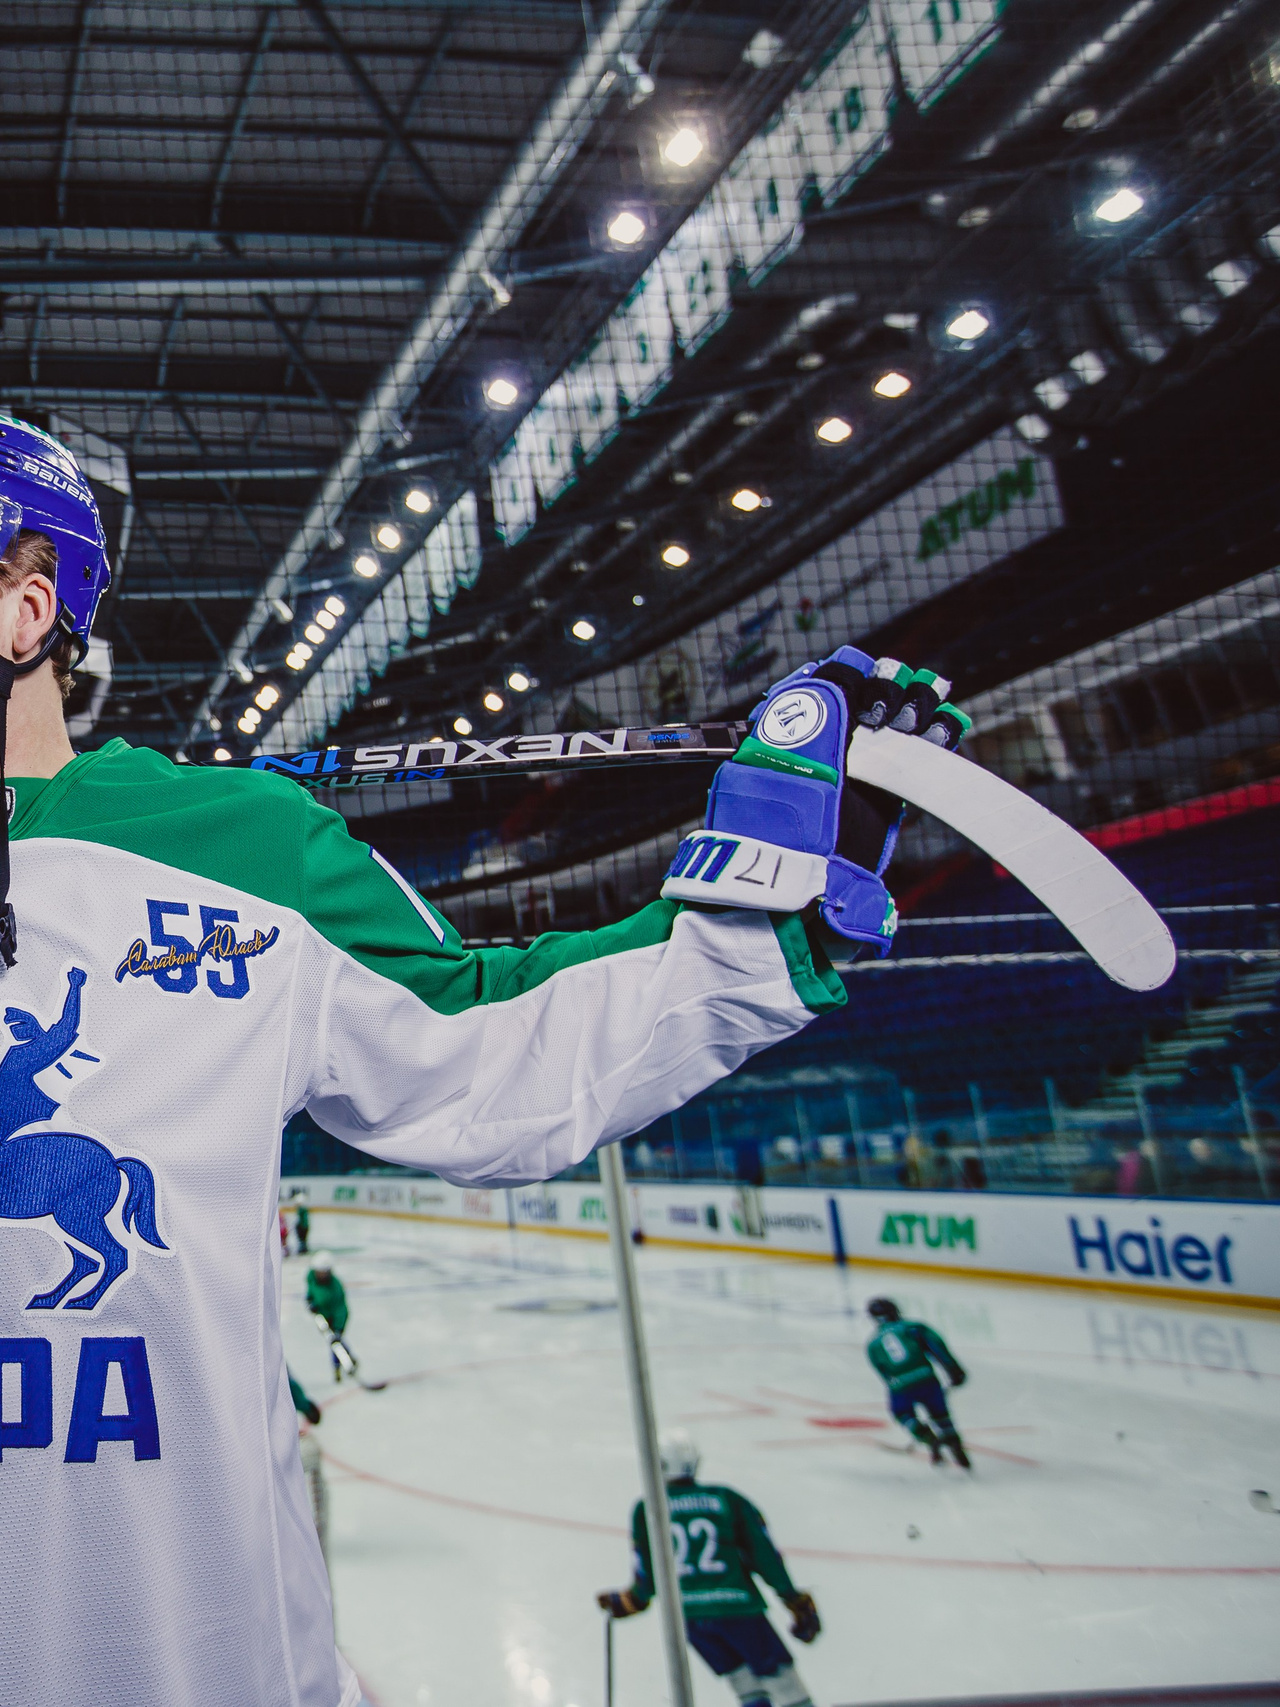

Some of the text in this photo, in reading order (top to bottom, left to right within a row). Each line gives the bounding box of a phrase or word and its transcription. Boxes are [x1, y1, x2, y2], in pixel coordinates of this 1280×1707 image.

[23, 462, 94, 507] BAUER
[916, 457, 1035, 563] ATUM
[351, 729, 628, 771] NEXUS
[733, 848, 783, 889] 17
[145, 898, 251, 1000] 55
[880, 1211, 977, 1253] ATUM
[1066, 1213, 1234, 1285] Haier
